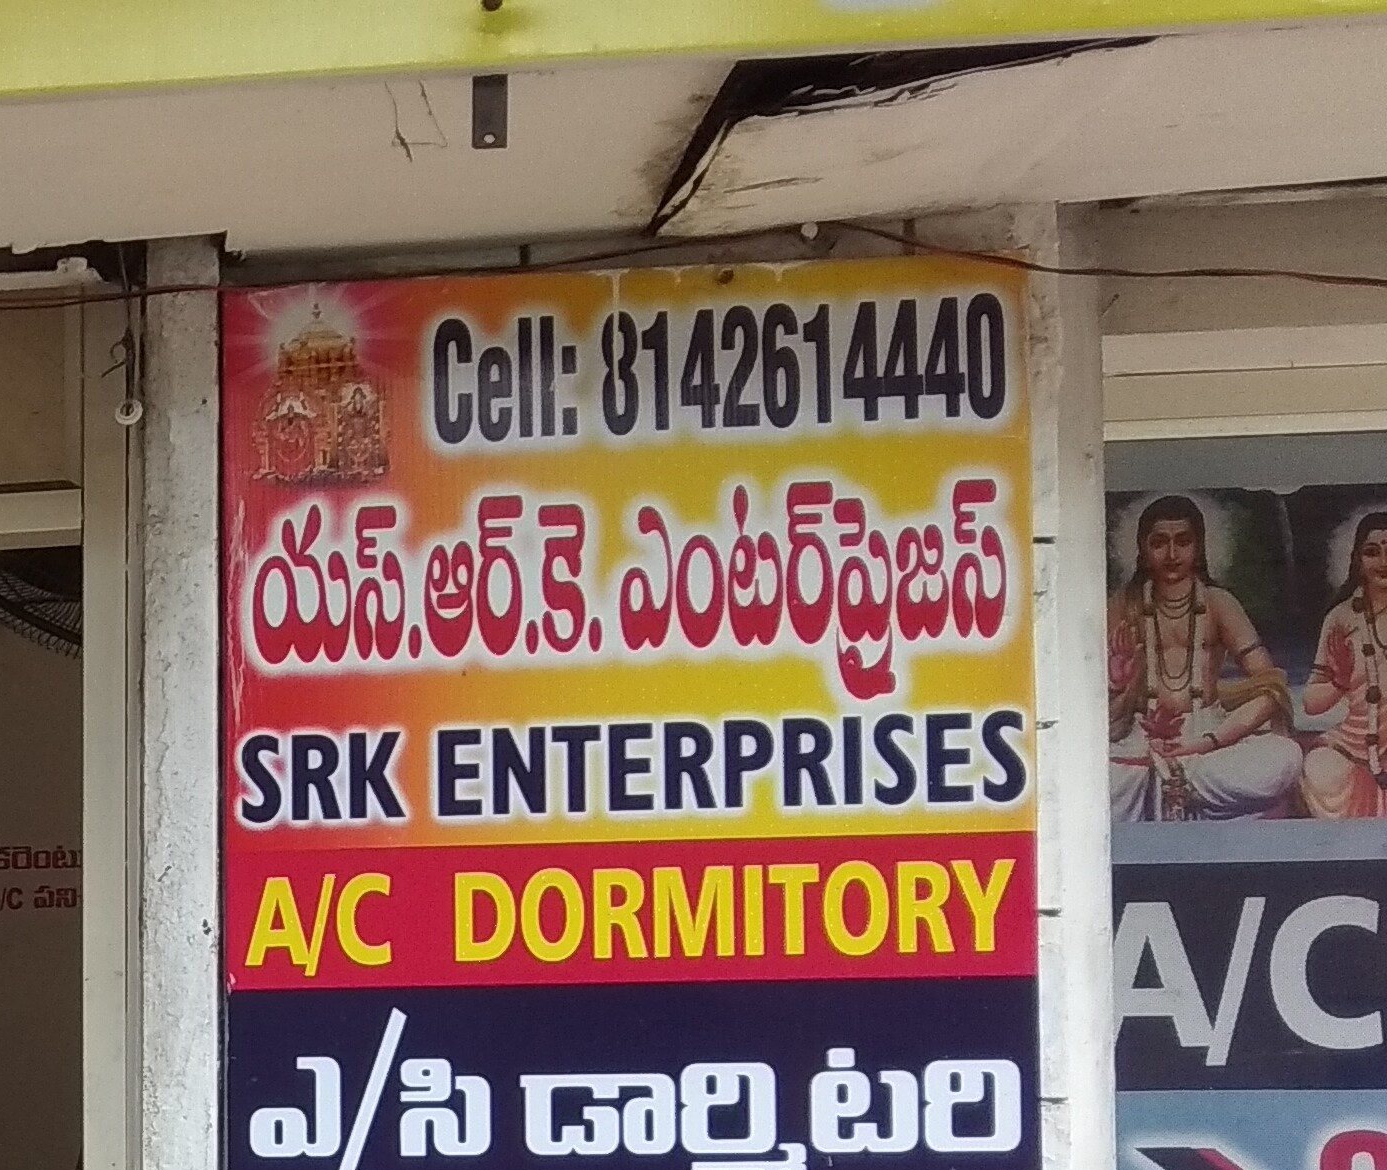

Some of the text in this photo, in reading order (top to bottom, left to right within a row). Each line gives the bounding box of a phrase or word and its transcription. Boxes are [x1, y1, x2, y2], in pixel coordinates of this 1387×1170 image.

[433, 291, 1008, 445] Cell: 8142614440
[239, 709, 1029, 824] SRK ENTERPRISES
[244, 858, 1017, 978] A/C DORMITORY
[1113, 894, 1384, 1067] A/C
